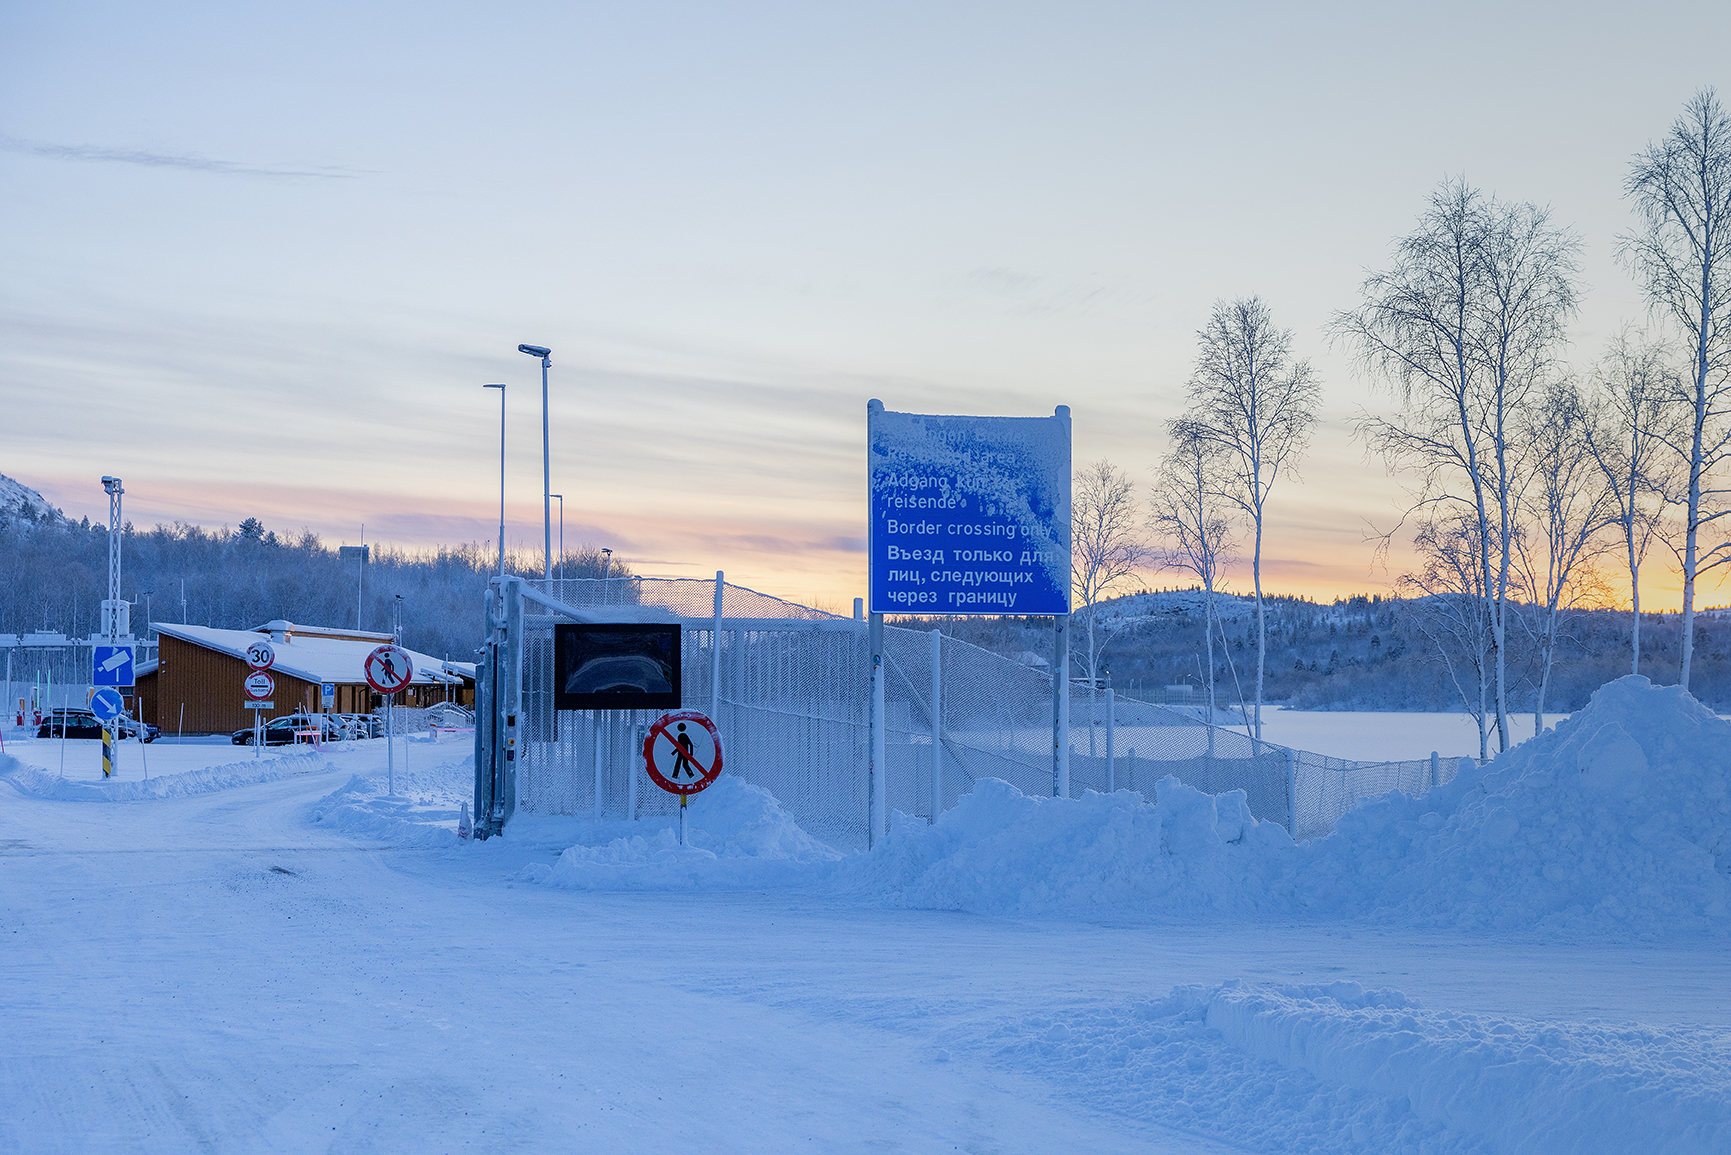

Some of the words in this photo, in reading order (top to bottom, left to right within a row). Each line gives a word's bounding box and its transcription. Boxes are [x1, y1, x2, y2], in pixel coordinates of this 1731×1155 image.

[888, 471, 948, 491] Adgang
[887, 493, 956, 509] reisende
[887, 519, 942, 535] Border
[947, 521, 1015, 539] crossing
[887, 545, 944, 564] Въезд
[953, 549, 1013, 561] только
[1020, 550, 1054, 565] для
[887, 570, 926, 585] лиц,
[930, 570, 1034, 586] следующих
[887, 591, 938, 606] через
[948, 592, 1017, 607] границу
[252, 650, 270, 663] 30
